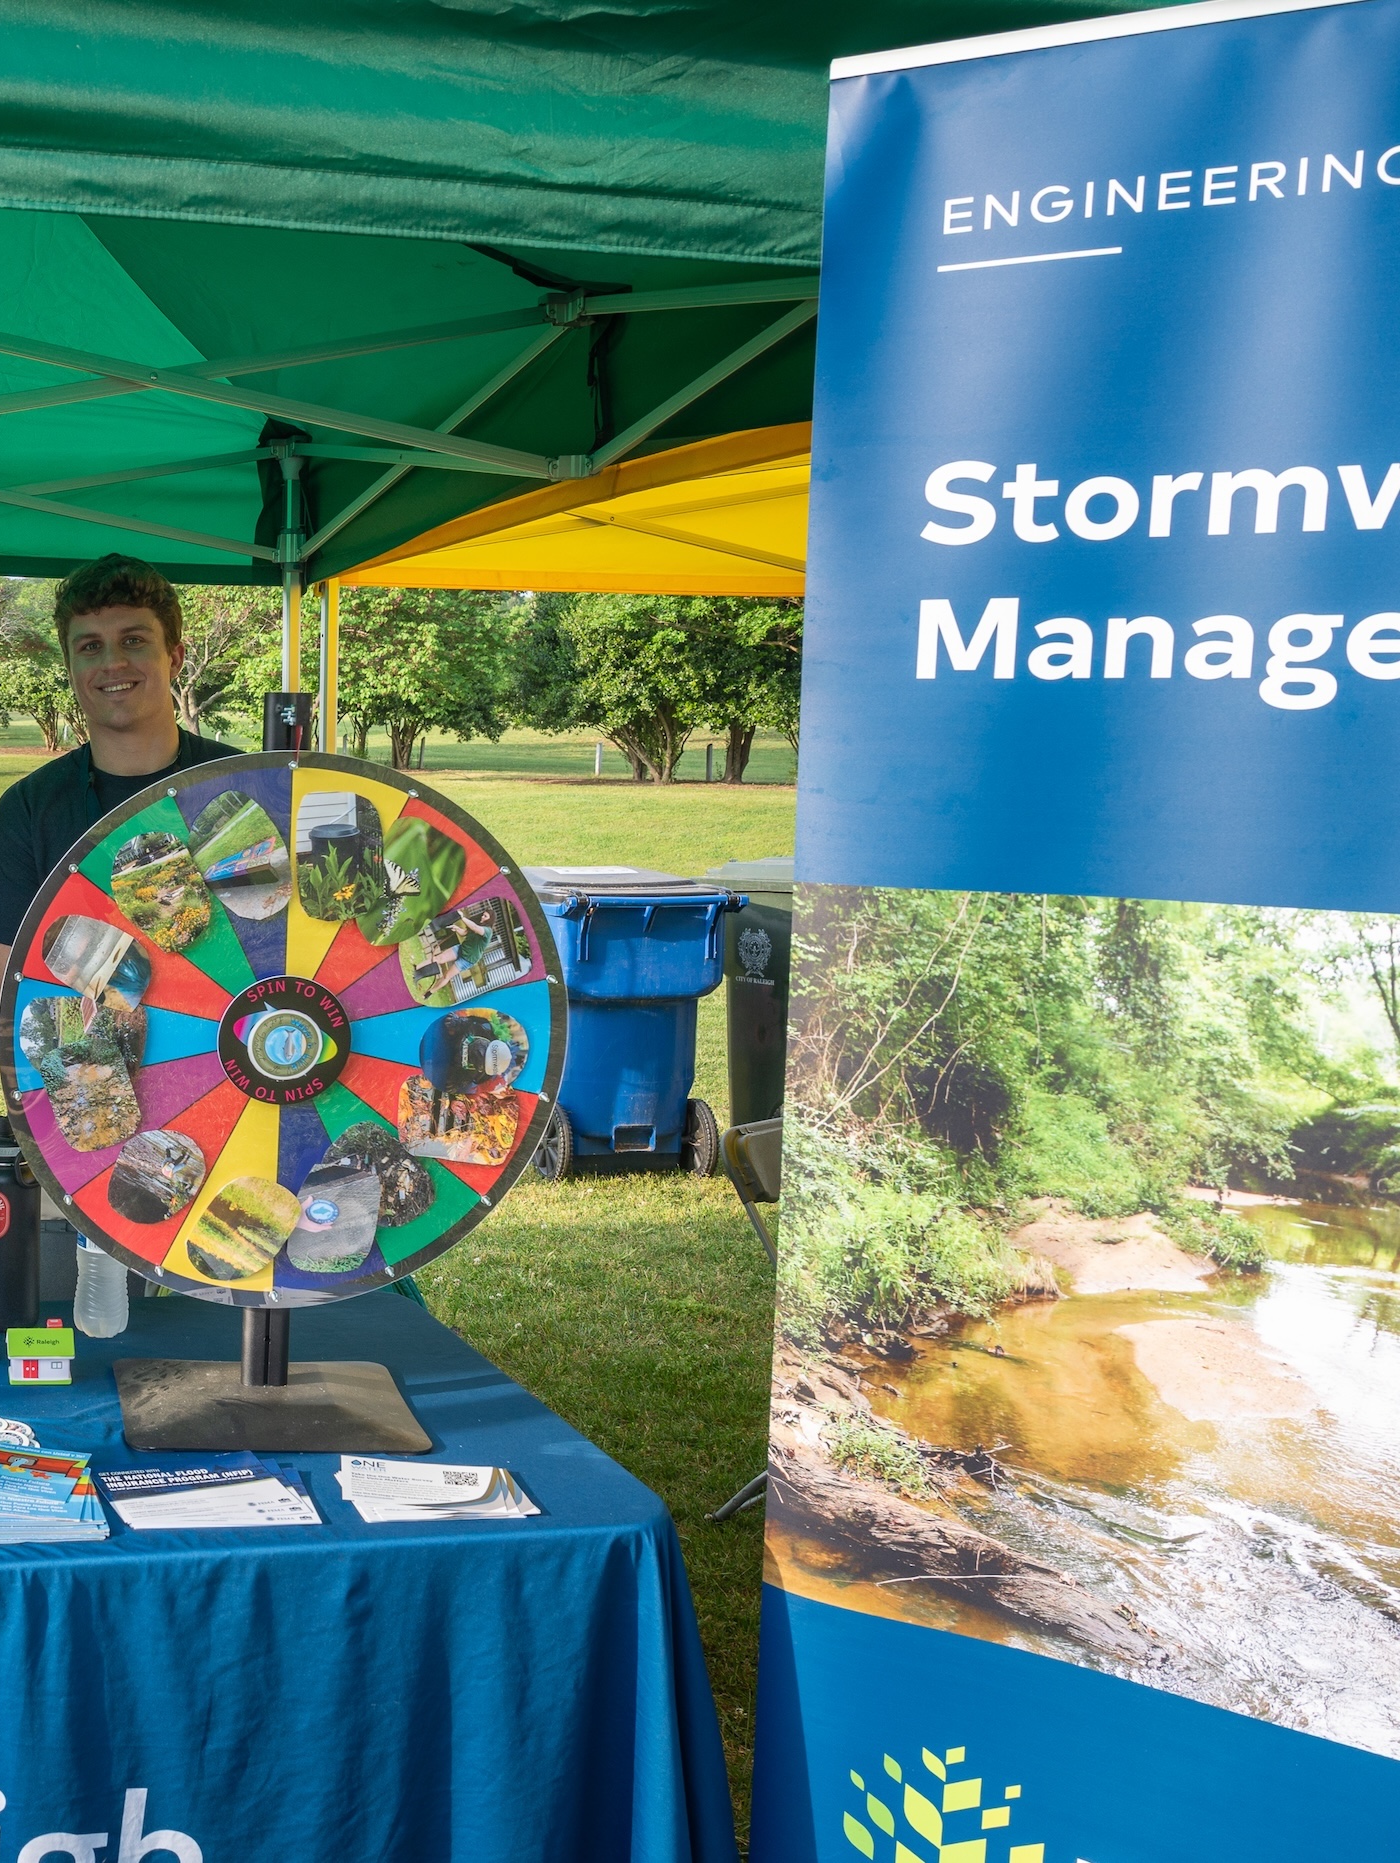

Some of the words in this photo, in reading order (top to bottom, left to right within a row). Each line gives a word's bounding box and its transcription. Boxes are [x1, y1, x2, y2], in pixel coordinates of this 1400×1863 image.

[916, 597, 1400, 711] Manage
[247, 981, 285, 1002] SPIN
[295, 982, 315, 997] TO
[320, 996, 344, 1028] WIN
[225, 1059, 250, 1090] WIN
[255, 1087, 276, 1101] TO
[285, 1078, 323, 1101] SPIN
[351, 1460, 385, 1468] ONE
[106, 1478, 167, 1488] INSURANCE
[168, 1473, 220, 1484] PROGRAM
[222, 1469, 254, 1479] (NFIP)
[124, 1471, 174, 1481] NATIONAL
